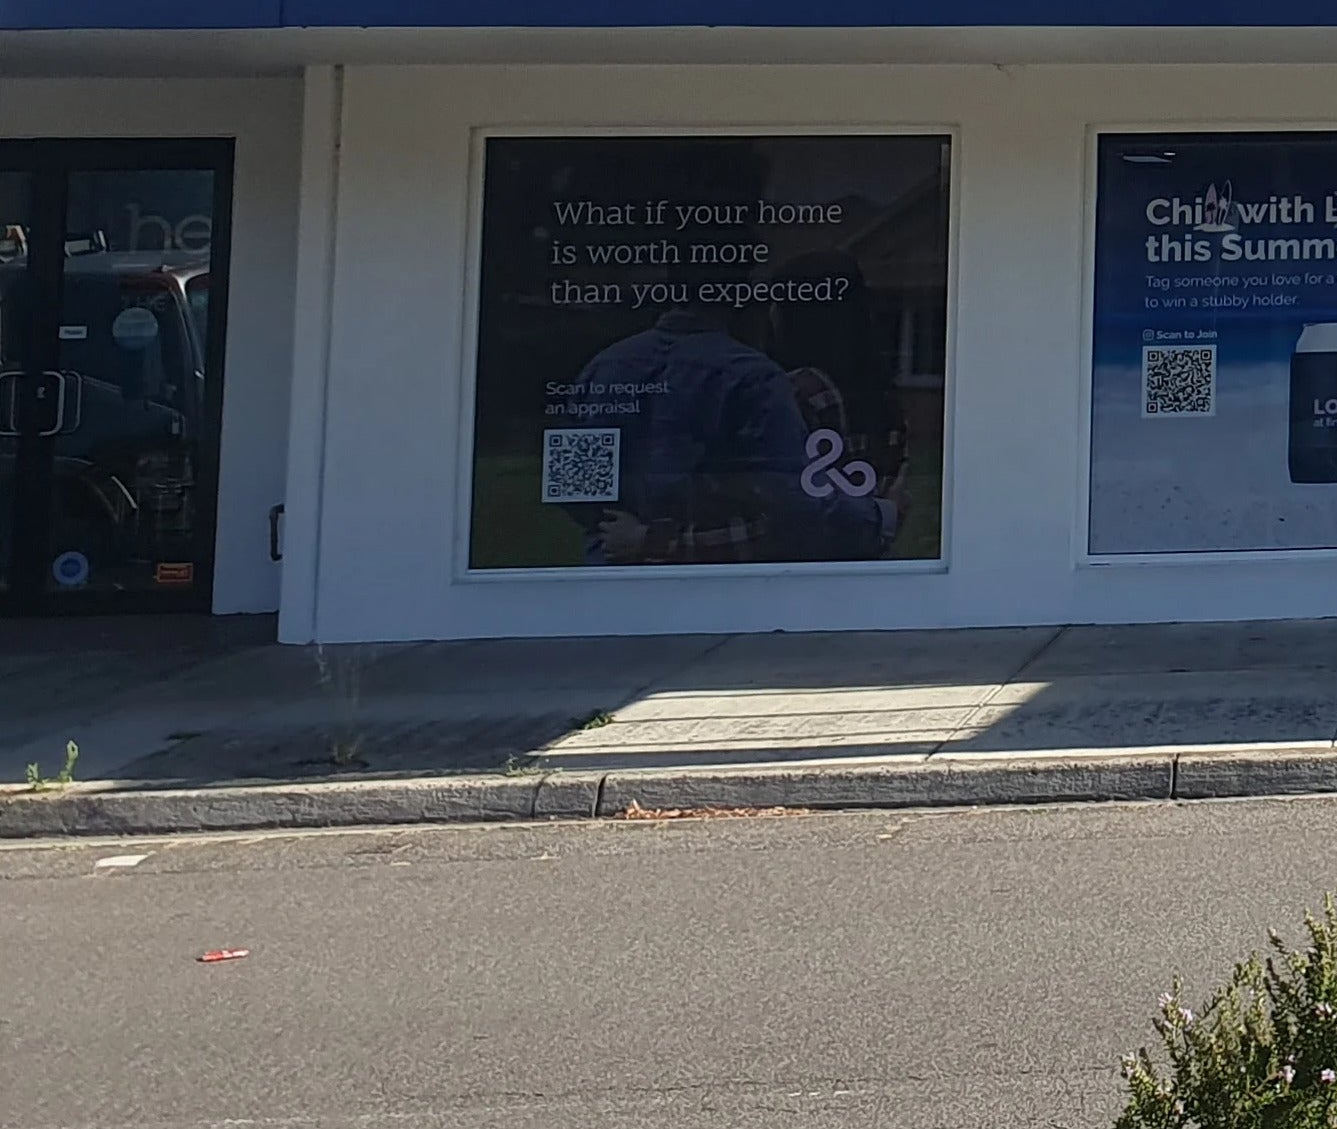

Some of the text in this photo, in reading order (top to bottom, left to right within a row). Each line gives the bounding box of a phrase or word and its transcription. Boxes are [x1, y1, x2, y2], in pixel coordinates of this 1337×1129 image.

[553, 200, 843, 231] What if your home
[1236, 195, 1314, 224] with
[551, 240, 769, 265] is worth more
[1146, 234, 1212, 263] this
[1146, 275, 1170, 291] Tag
[1174, 276, 1238, 287] someone
[1241, 276, 1268, 288] you
[1271, 273, 1301, 286] love
[1304, 272, 1323, 285] for
[1326, 275, 1334, 285] a
[551, 277, 849, 309] than you expected?
[1145, 294, 1300, 310] to win a stubby holder.
[1156, 329, 1218, 339] Scan to Join
[545, 380, 669, 397] Scan to request
[544, 399, 641, 417] an appraisal
[1313, 418, 1324, 428] at
